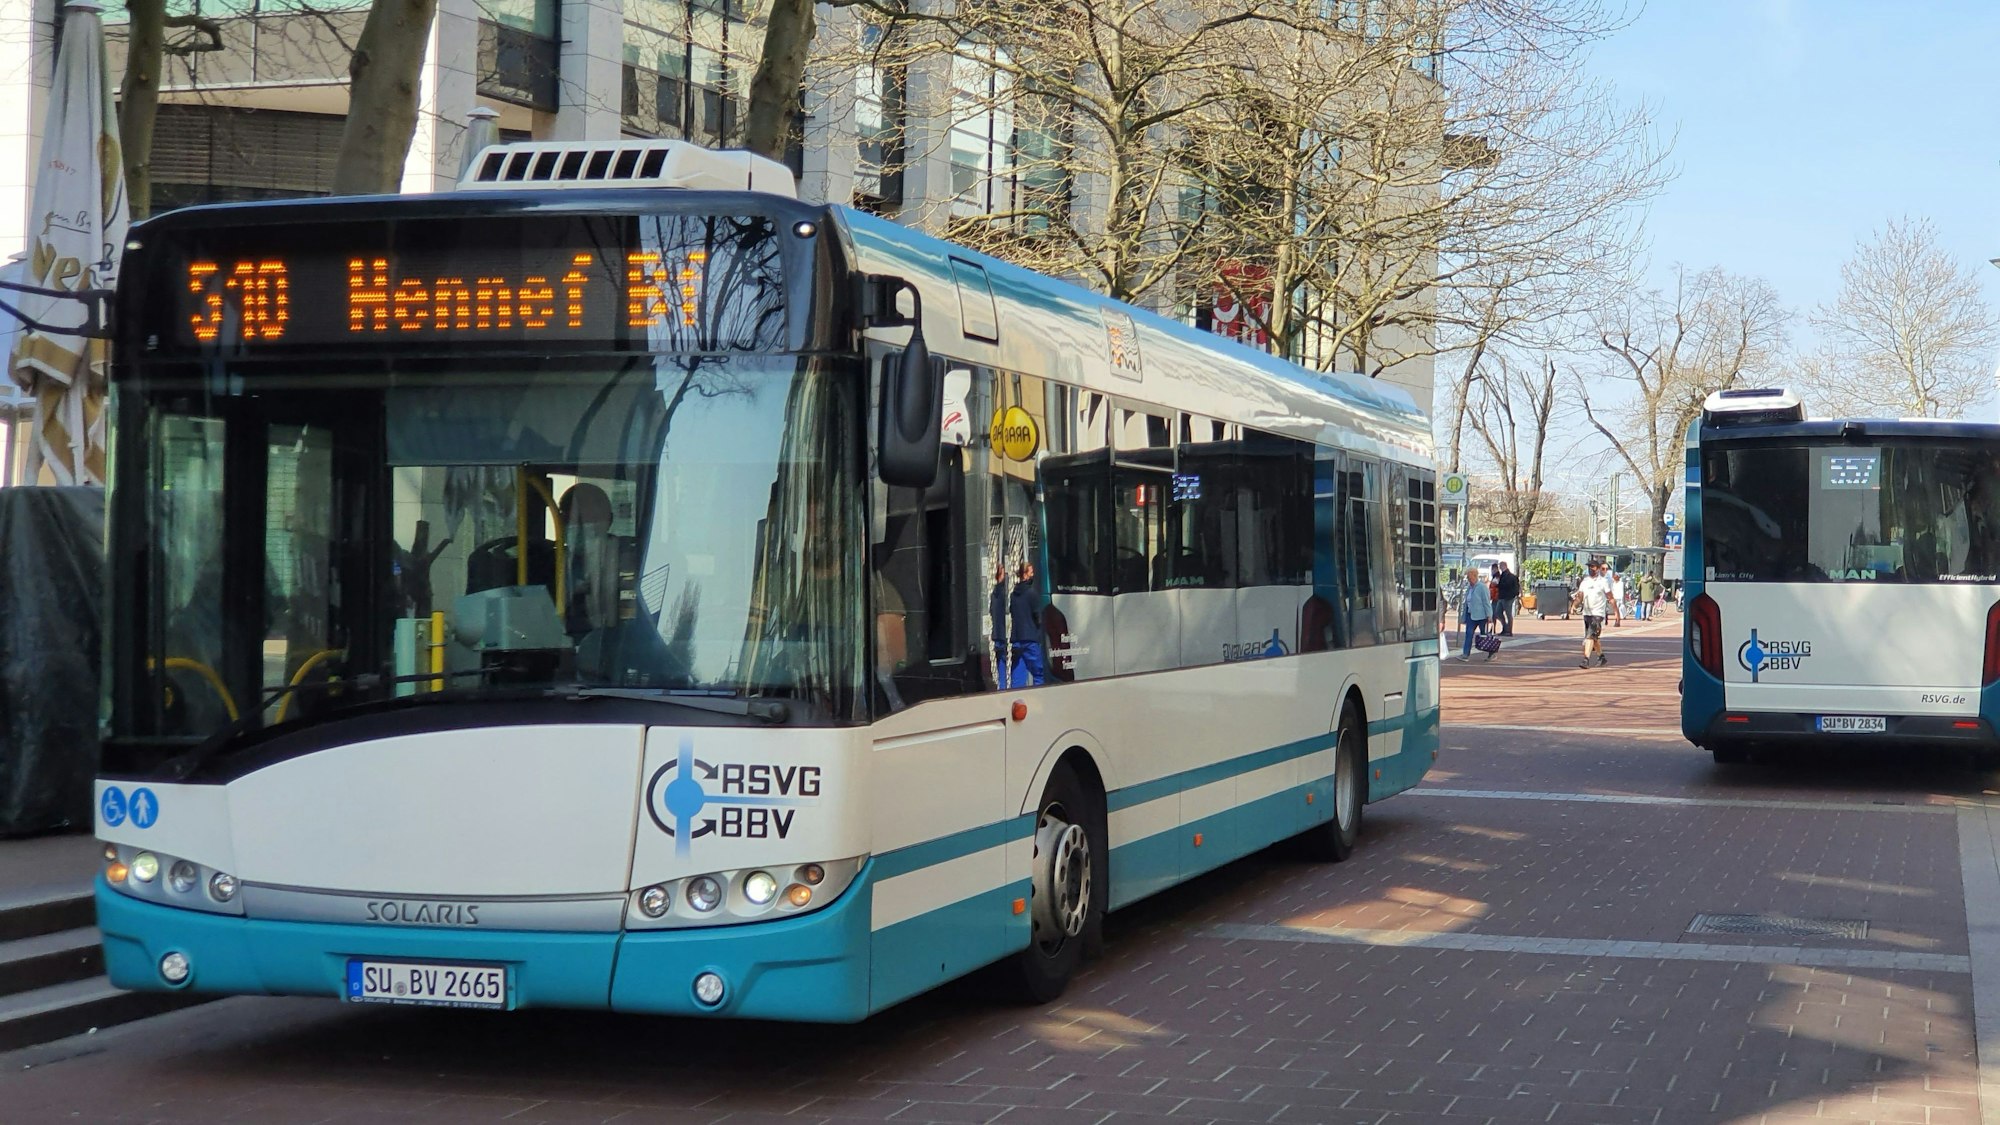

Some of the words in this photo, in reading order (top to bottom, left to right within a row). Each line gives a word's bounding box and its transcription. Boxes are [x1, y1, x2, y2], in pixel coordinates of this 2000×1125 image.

[191, 262, 288, 339] 510
[349, 253, 592, 331] Hennef
[628, 252, 706, 327] Bf
[1830, 457, 1876, 484] 557
[1829, 569, 1877, 580] MAN
[1770, 641, 1811, 654] RSVG
[1770, 657, 1801, 670] BBV
[1921, 694, 1966, 705] RSVG.de
[1822, 718, 1836, 729] SU
[1842, 718, 1856, 729] BV
[1858, 718, 1884, 730] 2834
[722, 763, 821, 797] RSVG
[720, 807, 796, 839] BBV
[366, 902, 480, 925] SOLARIS
[365, 967, 392, 994] SU
[410, 969, 438, 996] BV
[445, 971, 500, 999] 2665
